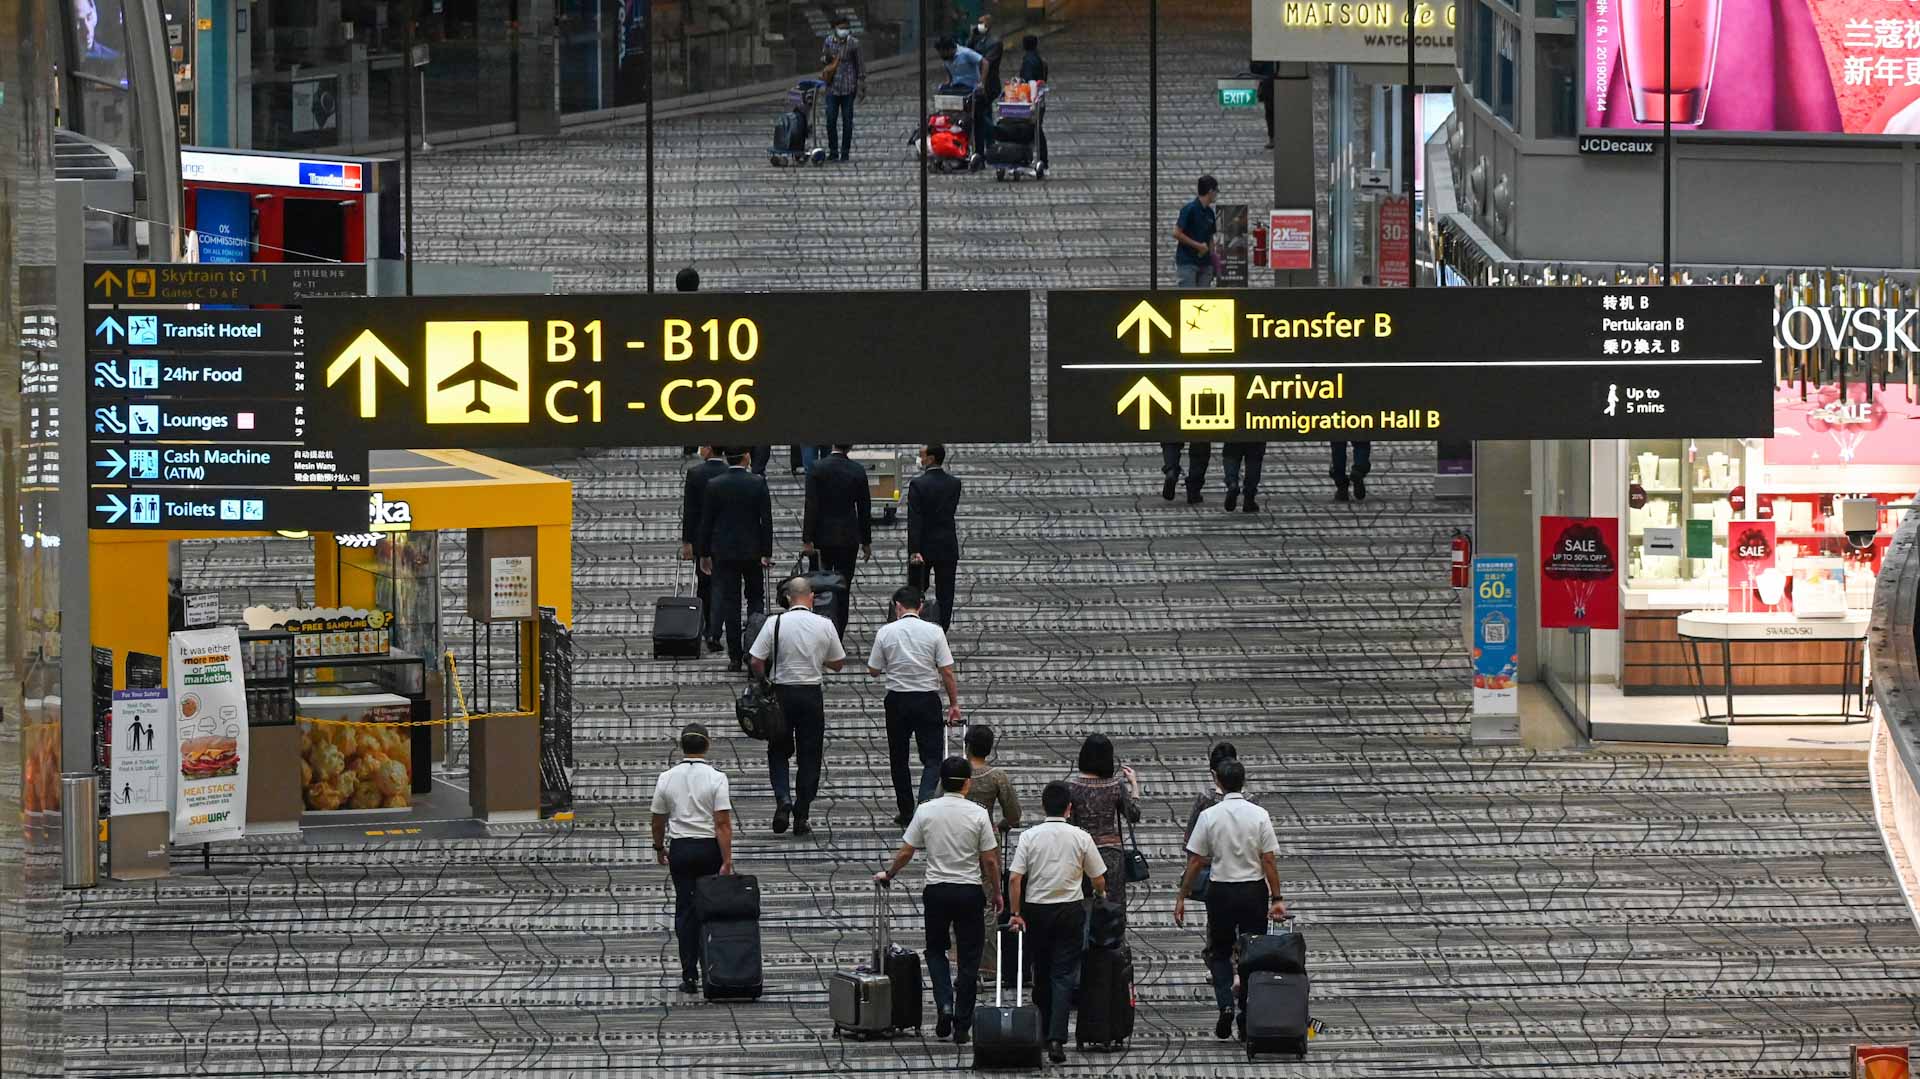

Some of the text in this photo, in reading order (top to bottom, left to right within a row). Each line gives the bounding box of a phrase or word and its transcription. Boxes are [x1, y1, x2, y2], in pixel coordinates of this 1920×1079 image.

[1286, 3, 1388, 24] MAISON
[1364, 35, 1454, 47] WATCH COLLE
[1223, 92, 1244, 104] EXIT
[1581, 139, 1653, 152] JCDecaux
[219, 224, 230, 233] 0%
[199, 235, 247, 247] COMMISSION
[161, 269, 268, 286] Skytrain to T1
[1603, 295, 1650, 310] 转机 B
[163, 323, 261, 337] Transit Hotel
[1246, 311, 1392, 338] Transfer B
[1603, 317, 1685, 331] Pertukaran B
[547, 320, 602, 362] B1
[664, 318, 759, 362] B10
[1603, 339, 1680, 354] 乗り換え B
[164, 366, 243, 382] 24hr Food
[1247, 373, 1343, 399] Arrival
[545, 380, 602, 423] C1
[660, 378, 756, 422] C26
[1627, 388, 1660, 401] Up to
[1627, 402, 1665, 413] 5 mins
[164, 413, 229, 430] Lounges
[1245, 410, 1441, 433] Immigration Hall B
[164, 449, 270, 464] Cash Machine
[164, 466, 205, 481] (ATM)
[294, 462, 337, 472] Mesin Wang
[165, 502, 215, 517] Toilets
[1565, 540, 1596, 552] SALE
[1739, 546, 1765, 557] SALE
[1480, 581, 1505, 599] 60
[302, 622, 323, 631] FREE
[326, 620, 367, 630] SAMPLING
[180, 643, 231, 656] It was either
[184, 654, 230, 665] more meat
[189, 811, 231, 825] SUBWAY
